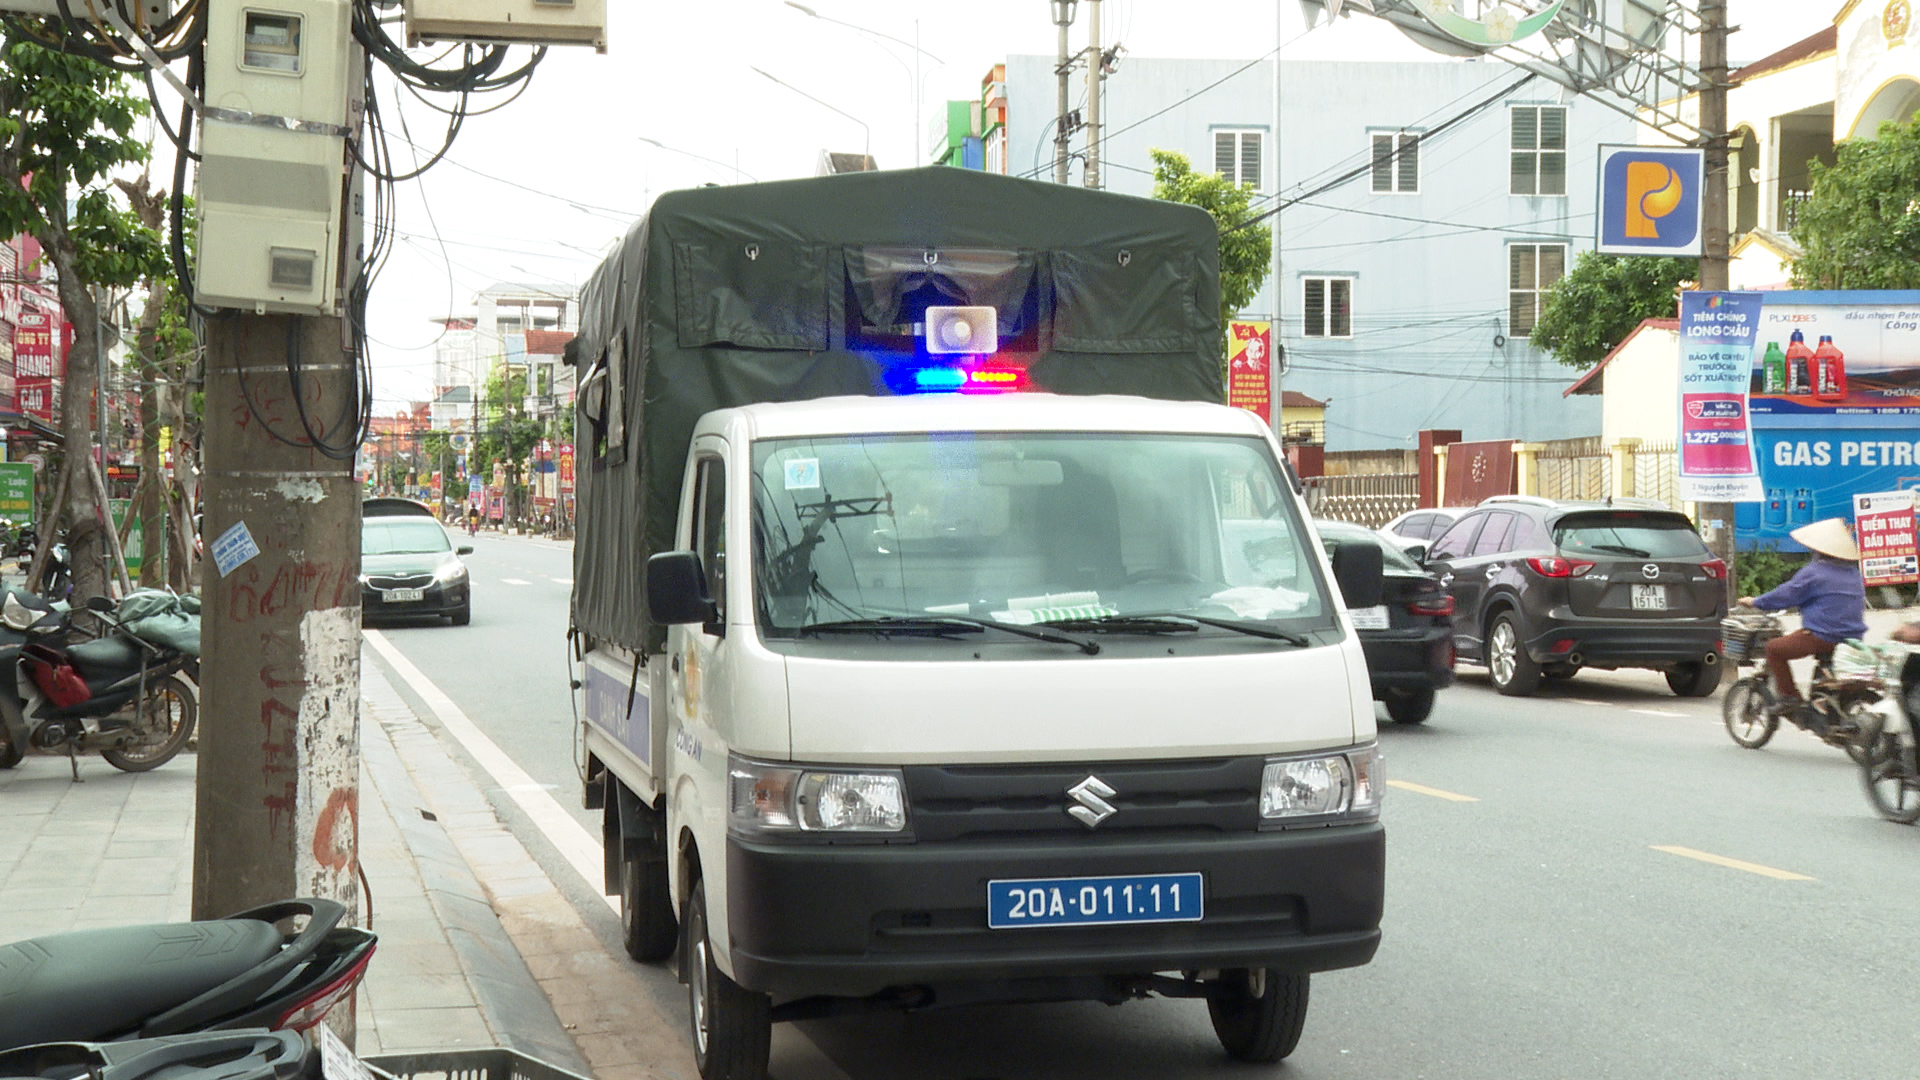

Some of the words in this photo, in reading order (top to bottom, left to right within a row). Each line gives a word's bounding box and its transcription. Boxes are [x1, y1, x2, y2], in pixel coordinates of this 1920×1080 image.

[1687, 326, 1722, 337] LONG
[1723, 324, 1750, 337] CHÂU
[1773, 441, 1831, 466] GAS
[1888, 516, 1911, 530] THAY
[1639, 586, 1657, 596] 20A
[1008, 883, 1181, 918] 20A-011.11
